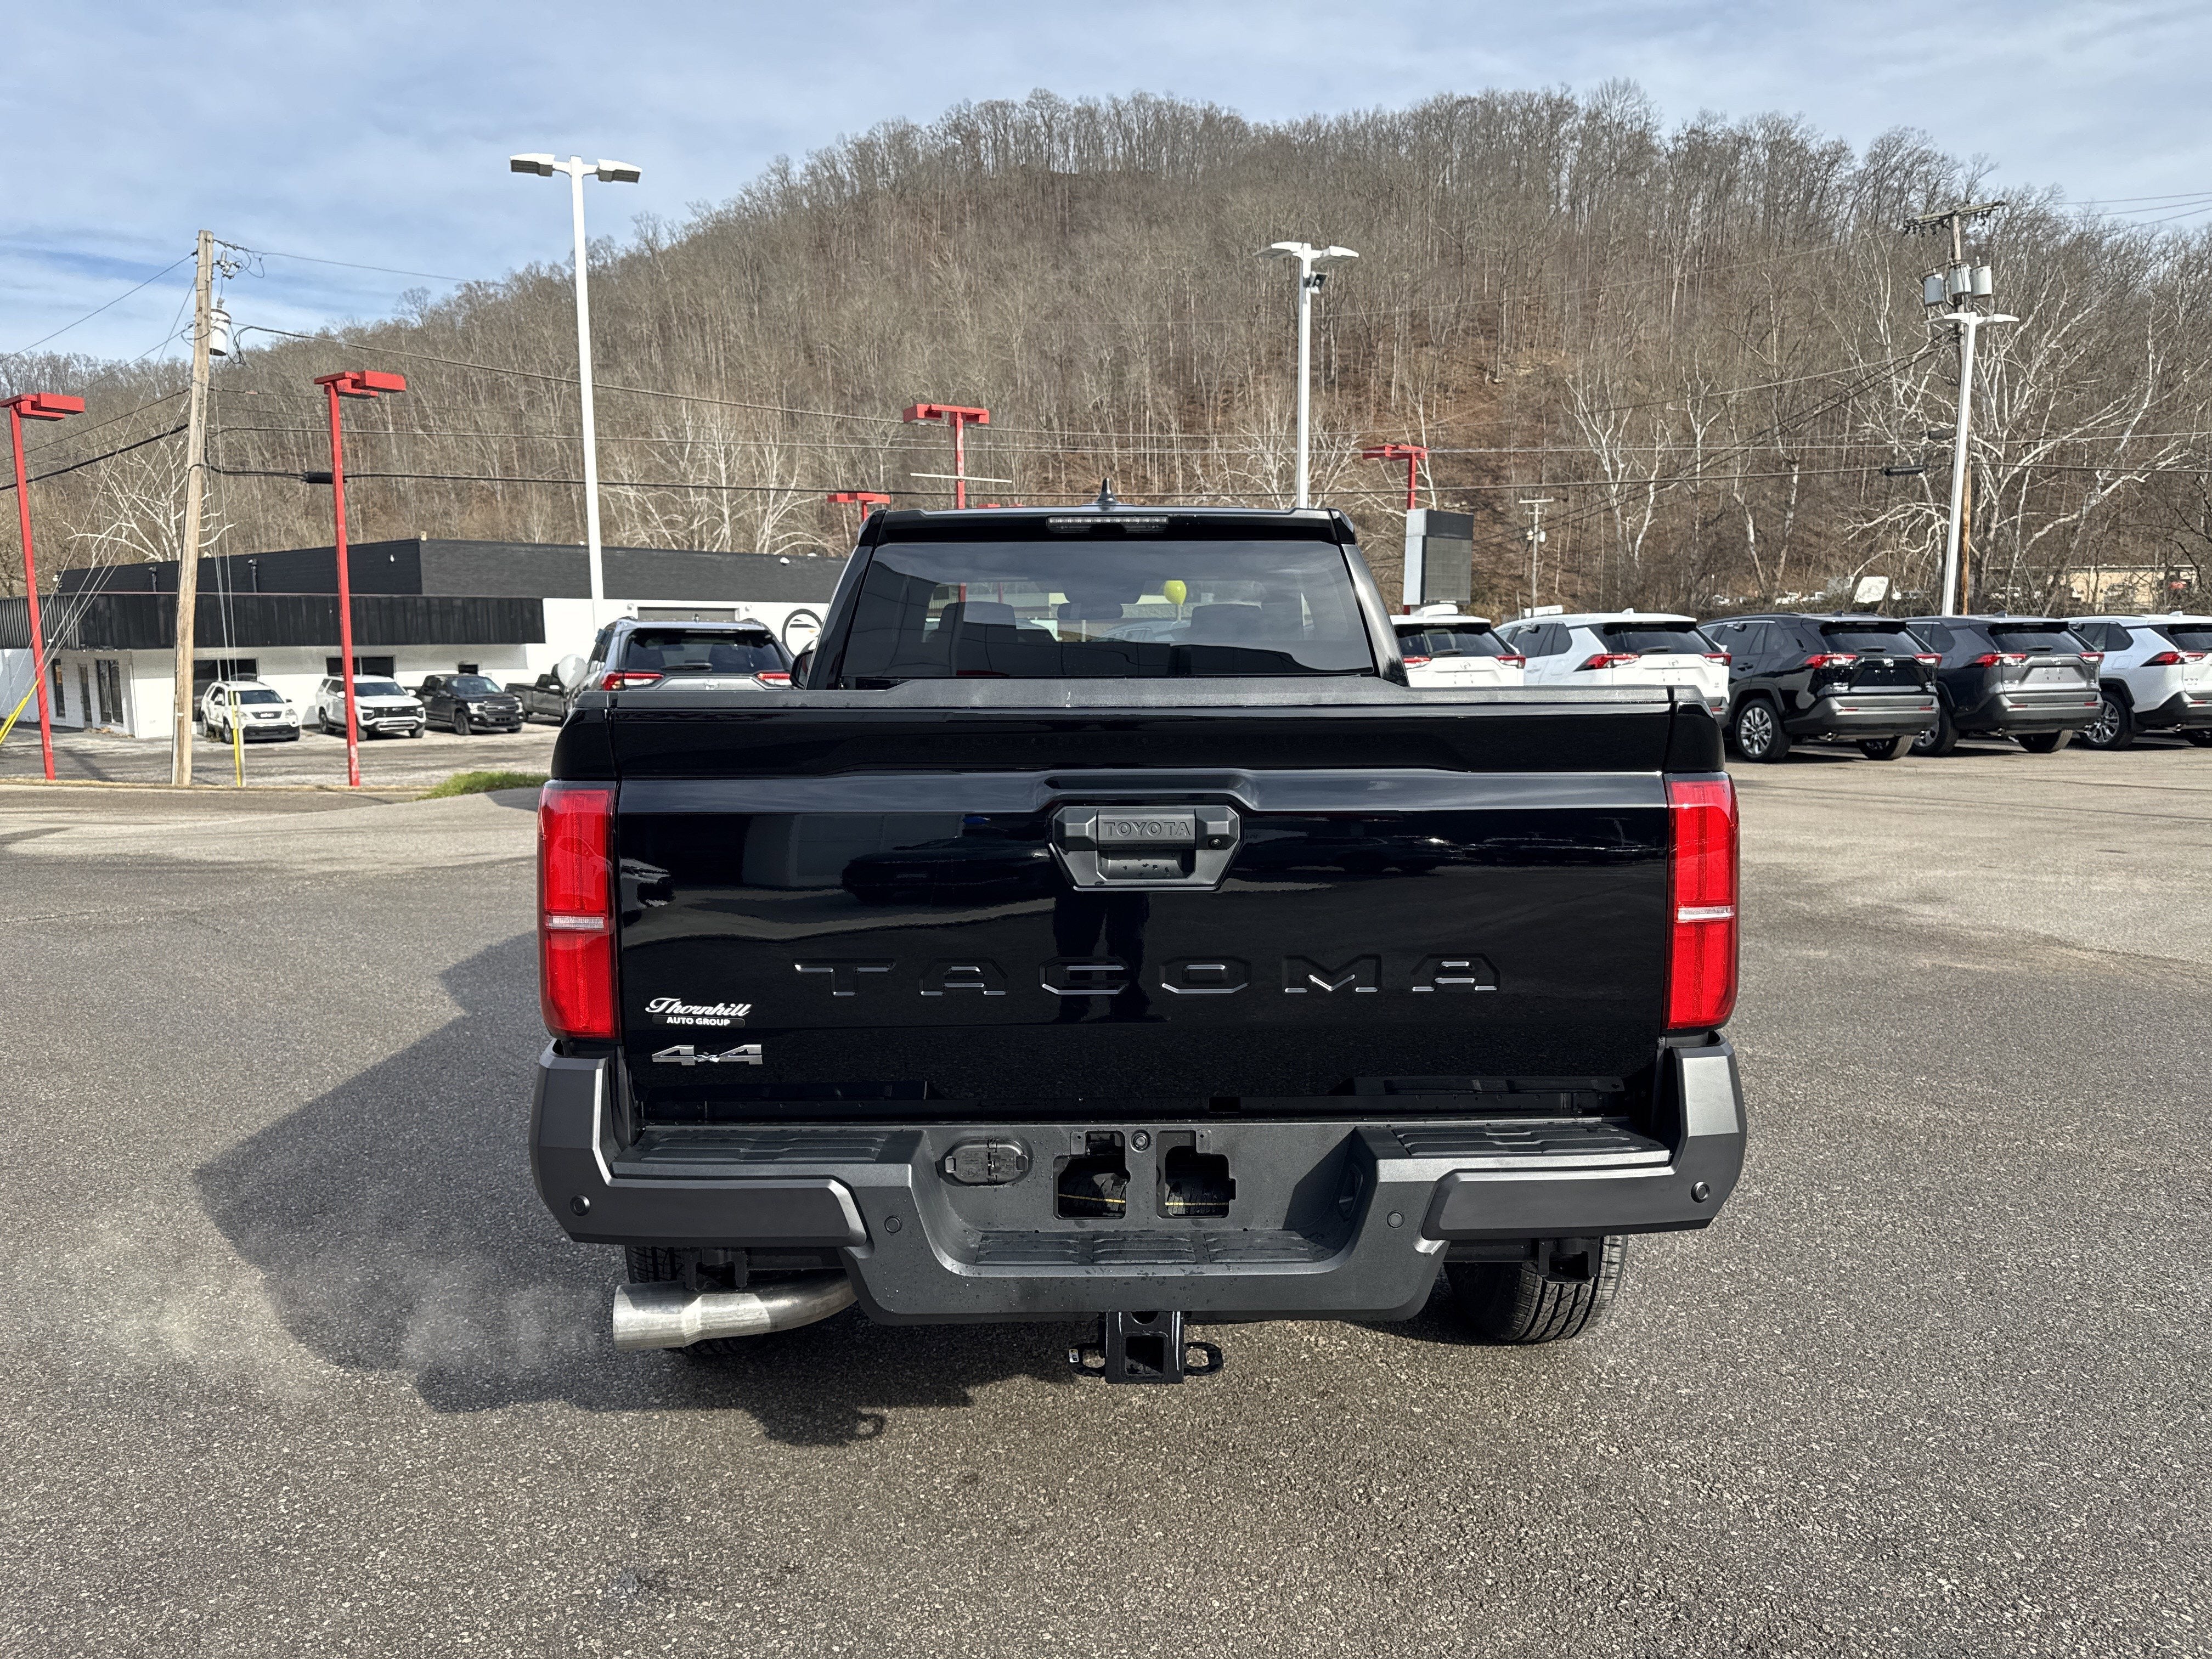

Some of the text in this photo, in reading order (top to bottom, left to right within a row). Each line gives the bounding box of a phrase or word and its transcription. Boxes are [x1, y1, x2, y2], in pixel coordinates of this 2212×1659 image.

[1103, 821, 1191, 837] TOYOTA
[792, 952, 1500, 996] TACOMA
[645, 997, 752, 1017] Thornhill
[667, 1017, 731, 1026] AUTO GROUP
